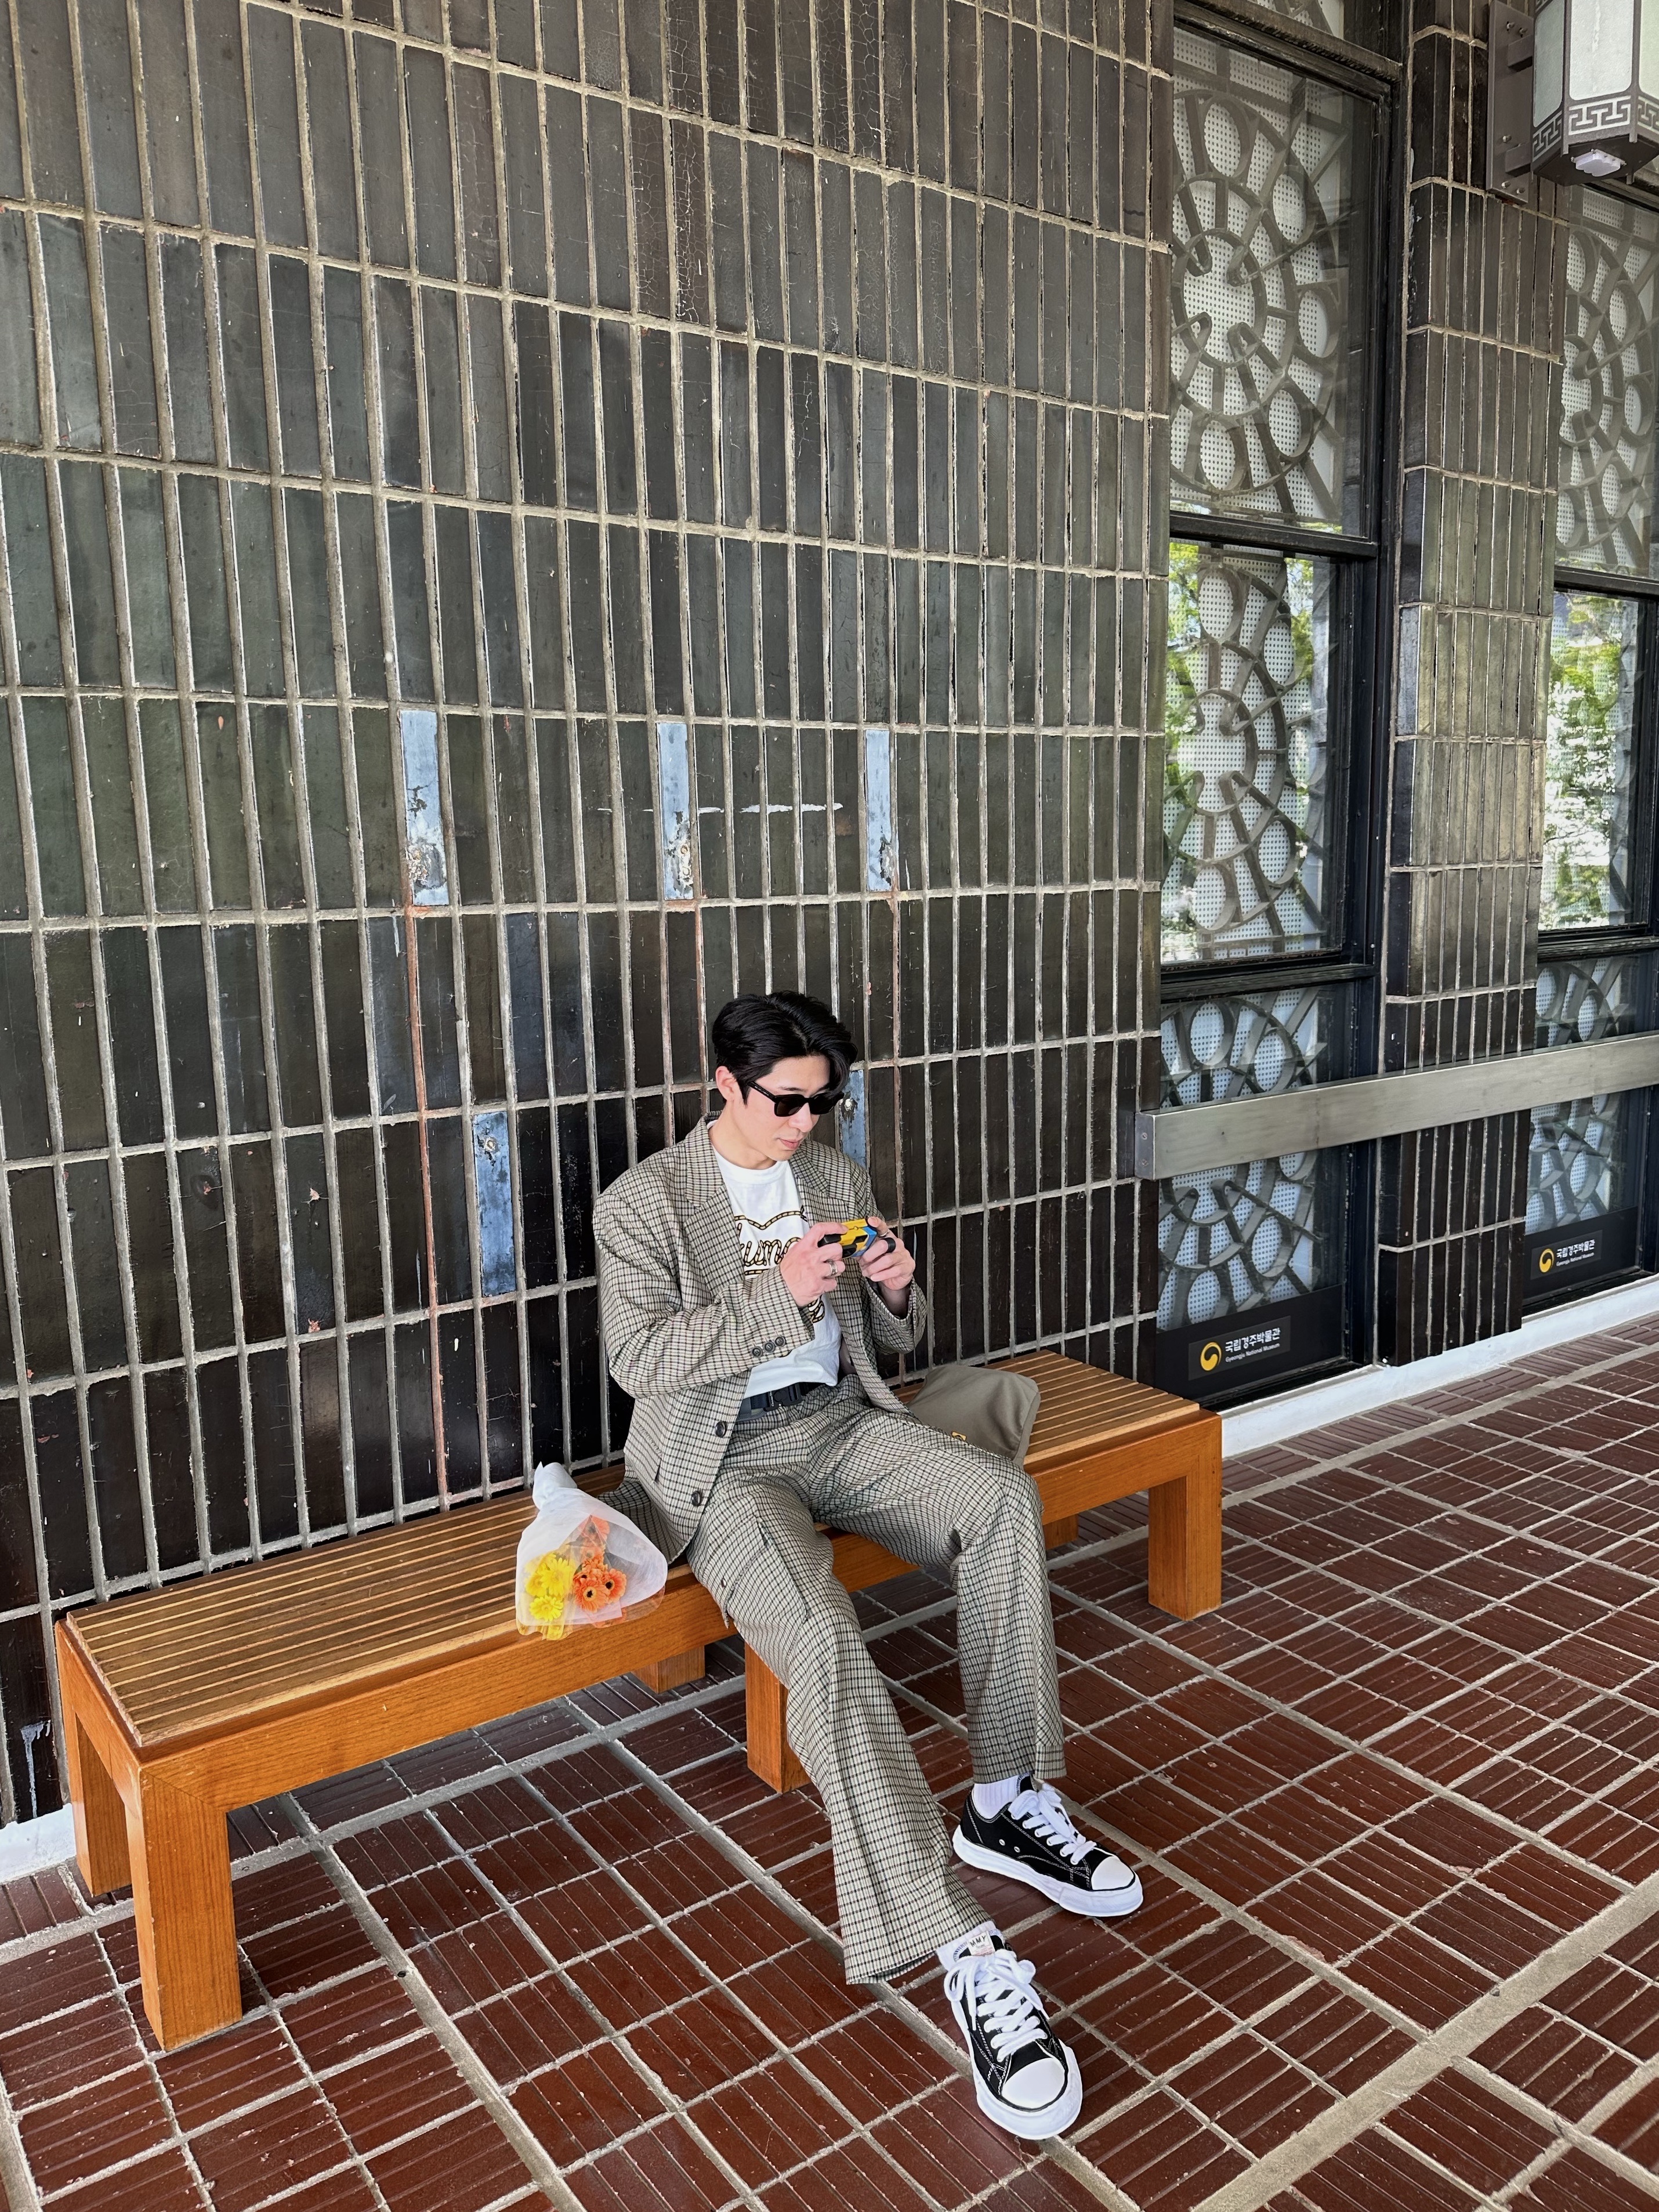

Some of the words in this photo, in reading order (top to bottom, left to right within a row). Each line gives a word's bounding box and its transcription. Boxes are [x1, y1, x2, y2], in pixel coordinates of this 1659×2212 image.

[1556, 1239, 1595, 1258] 국립경주박물관
[1225, 1327, 1281, 1353] 국립경주박물관
[969, 1935, 986, 1947] MMY
